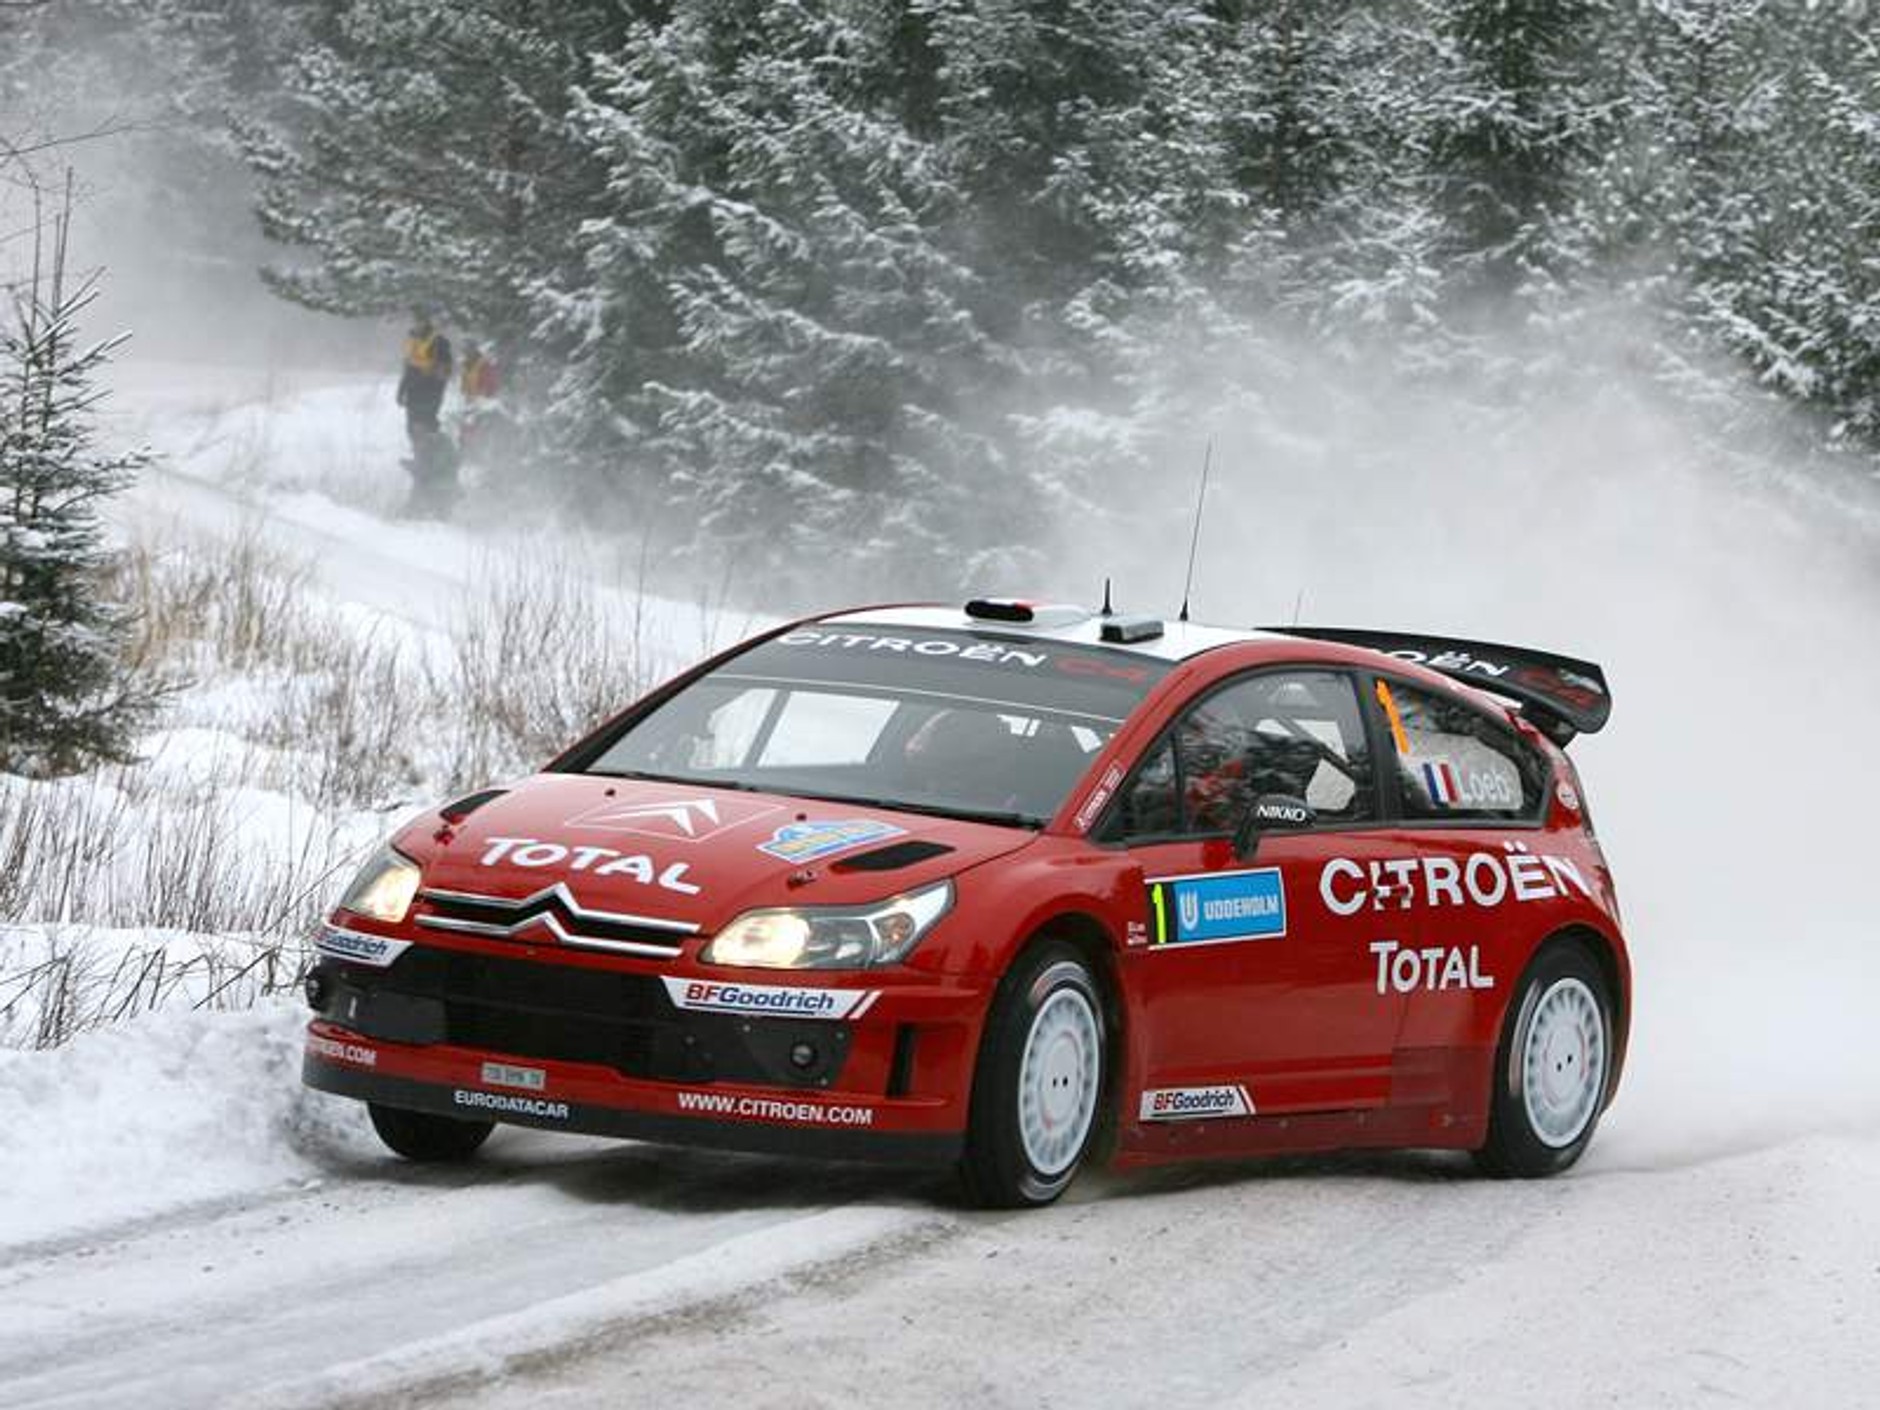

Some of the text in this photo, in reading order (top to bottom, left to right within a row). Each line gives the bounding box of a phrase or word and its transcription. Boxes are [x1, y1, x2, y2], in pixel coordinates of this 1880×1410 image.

[775, 632, 1047, 667] CITROËN
[1258, 805, 1306, 822] NIKKO
[480, 837, 701, 895] TOTAL
[1319, 841, 1591, 916] CITROËN
[1152, 884, 1166, 943] 1
[1204, 894, 1279, 921] UDDEHOLM
[1370, 941, 1494, 994] TOTAL
[686, 984, 834, 1010] BFGoodrich
[454, 1090, 569, 1118] EURODATACAR
[678, 1093, 873, 1125] WWW.CITROEN.COM
[1153, 1090, 1235, 1110] BFGoodrich
